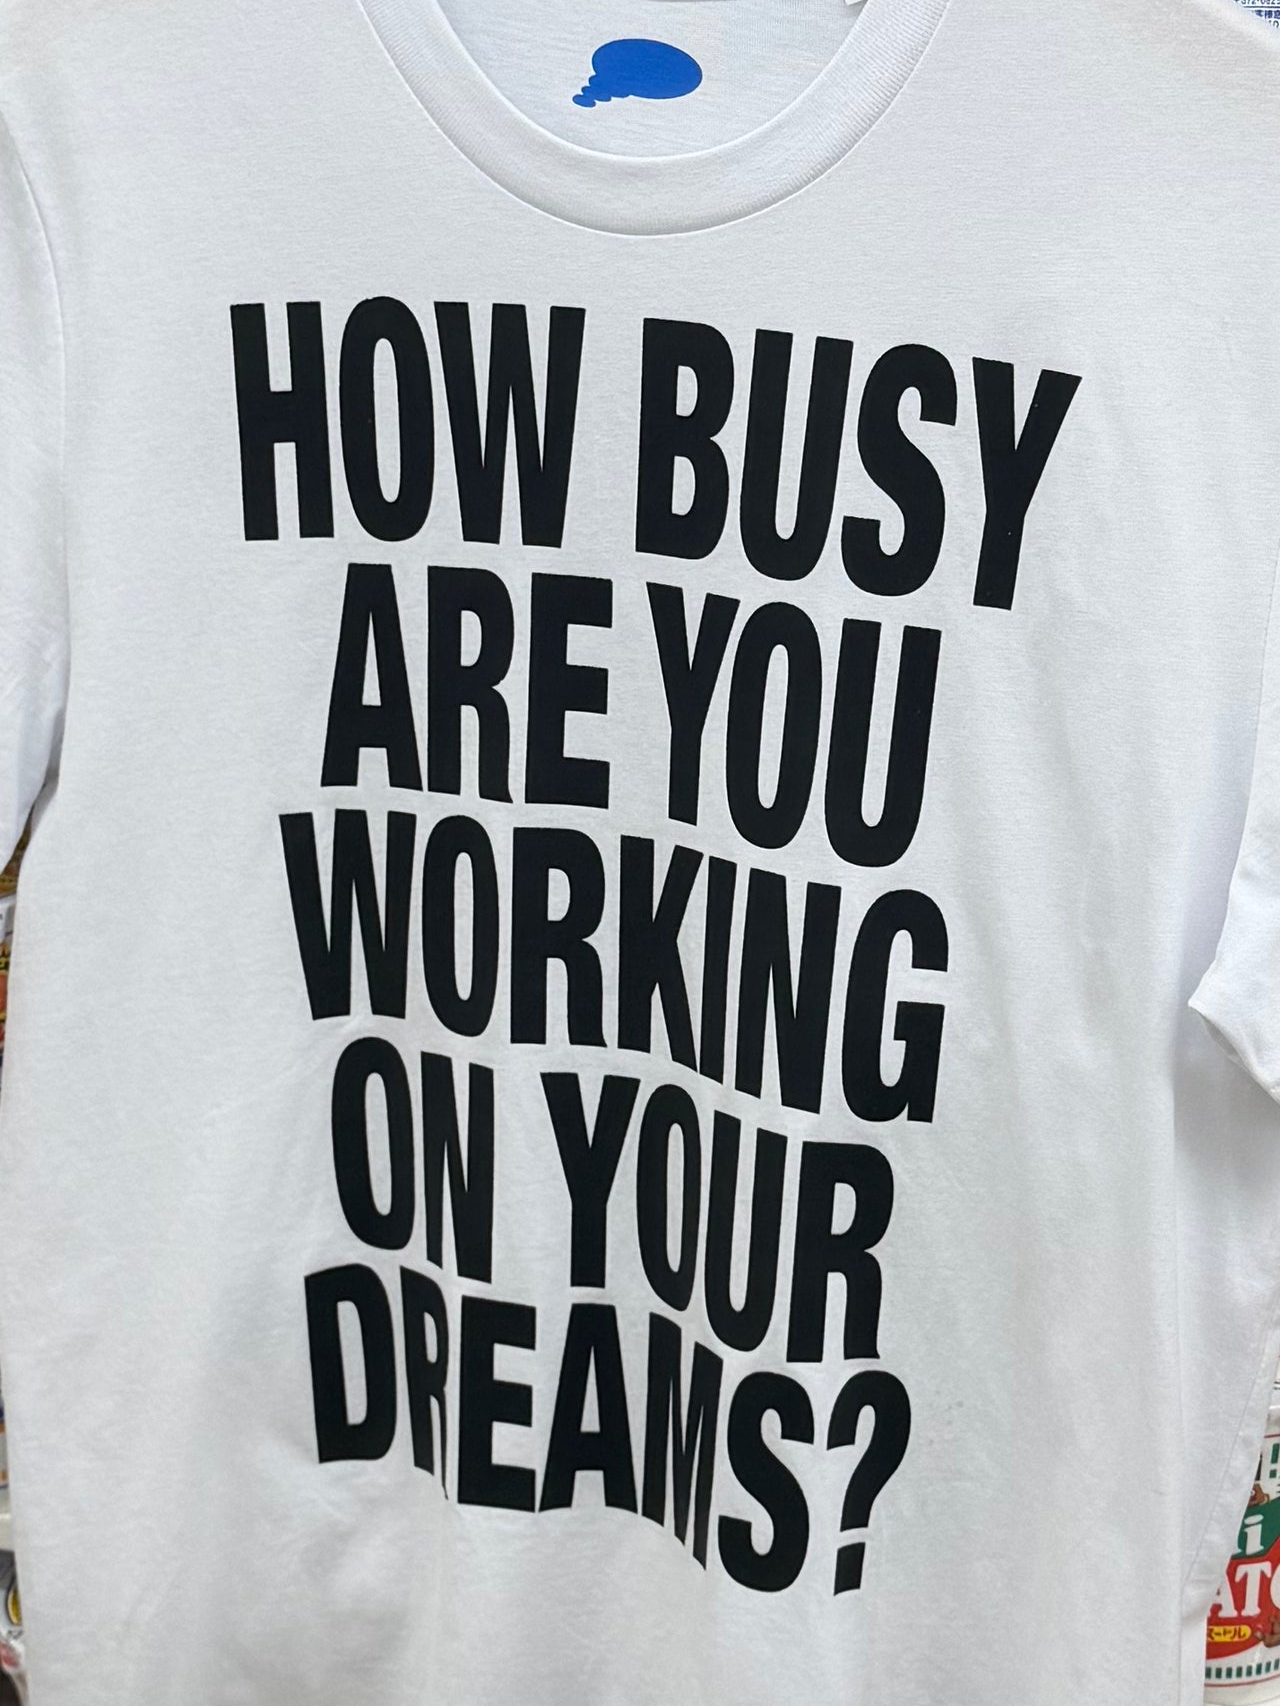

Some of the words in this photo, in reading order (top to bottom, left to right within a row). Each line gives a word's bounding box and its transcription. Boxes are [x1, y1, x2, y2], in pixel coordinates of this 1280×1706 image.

[228, 295, 587, 548] HOW
[634, 317, 1083, 610] BUSY
[320, 562, 613, 807] ARE
[645, 578, 942, 869] YOU
[278, 807, 950, 1125] WORKING
[331, 1036, 494, 1284] ON
[539, 1070, 895, 1364] YOUR
[302, 1262, 912, 1598] DREAMS?
